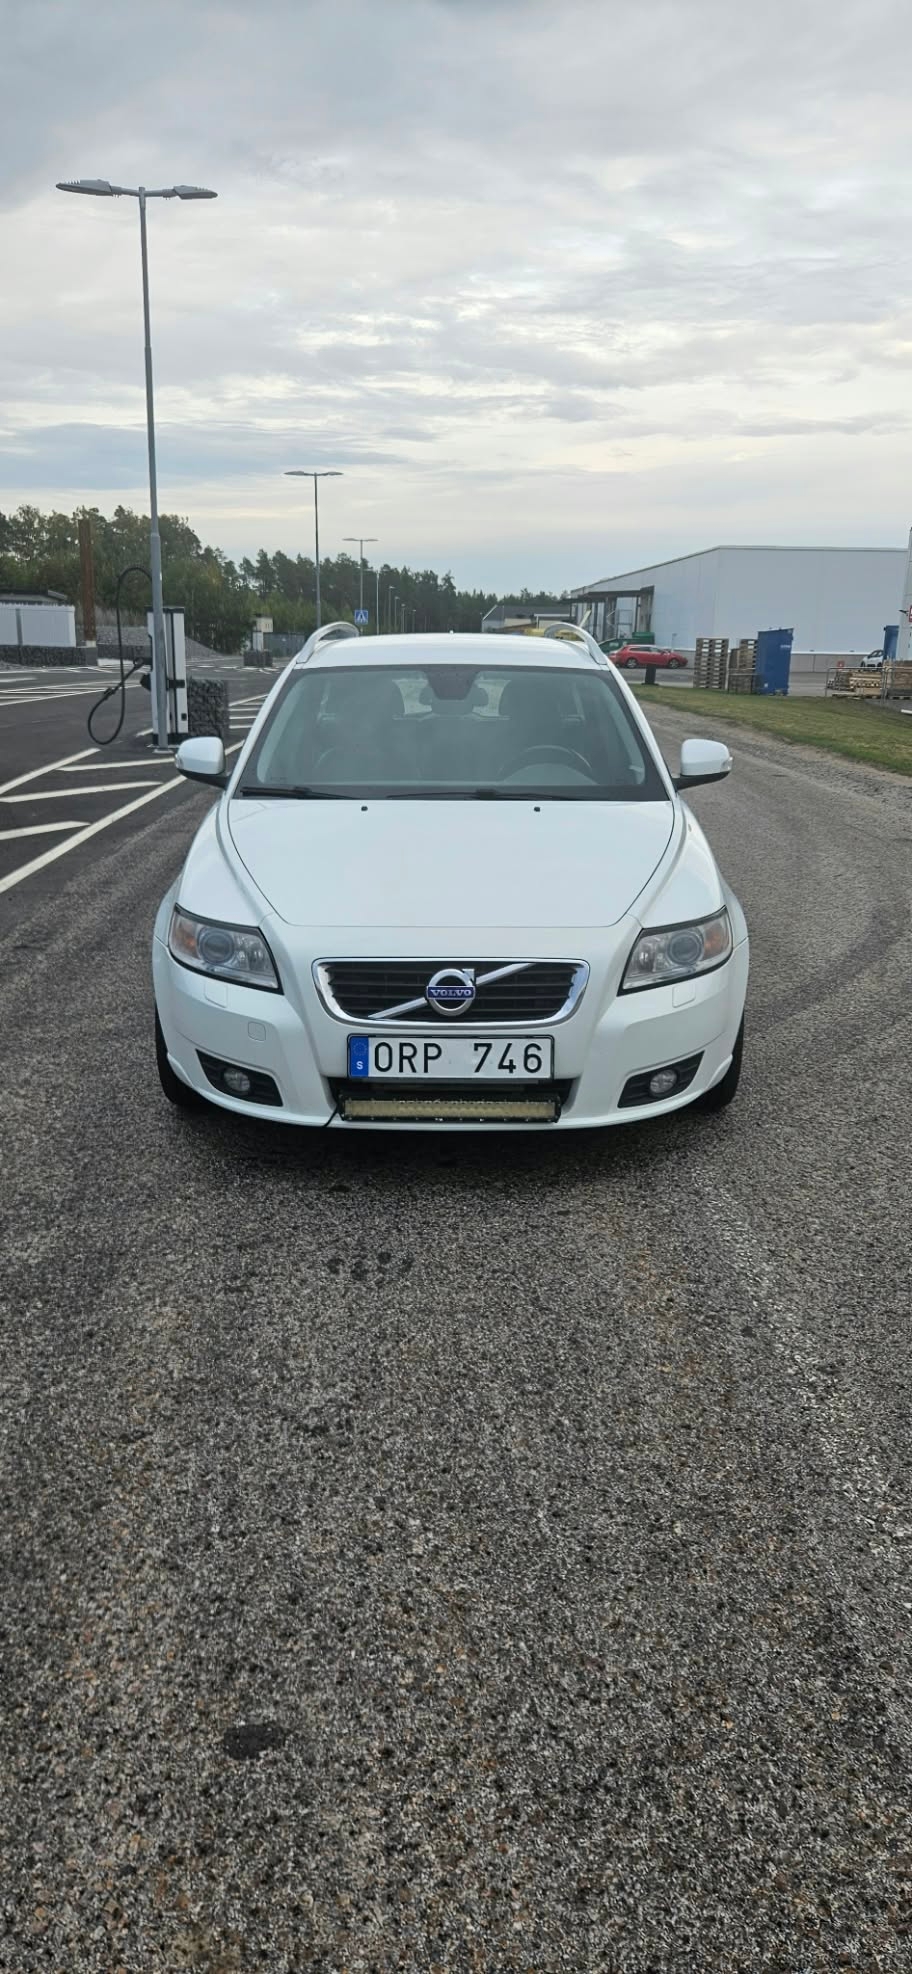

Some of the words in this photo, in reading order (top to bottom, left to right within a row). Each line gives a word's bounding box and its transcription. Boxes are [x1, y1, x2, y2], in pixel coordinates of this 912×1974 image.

[430, 989, 472, 997] VOLVO
[374, 1041, 442, 1073] ORP
[473, 1042, 543, 1073] 746
[356, 1060, 364, 1070] S
